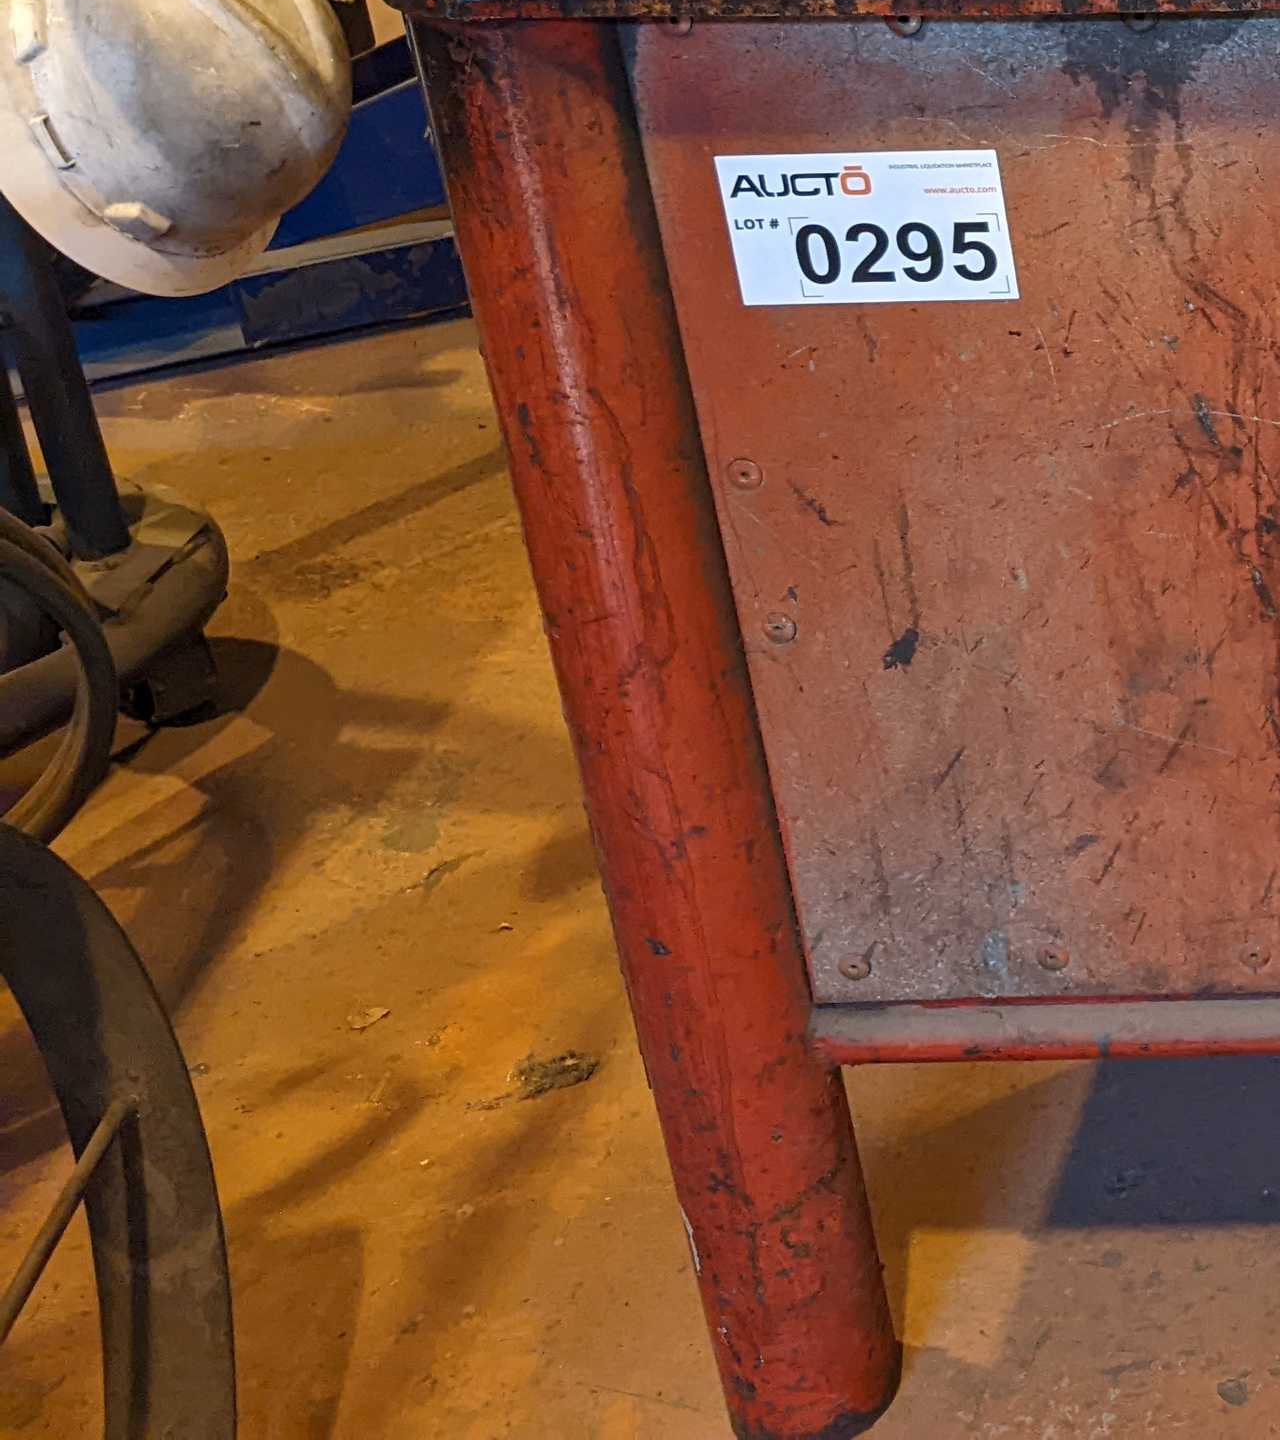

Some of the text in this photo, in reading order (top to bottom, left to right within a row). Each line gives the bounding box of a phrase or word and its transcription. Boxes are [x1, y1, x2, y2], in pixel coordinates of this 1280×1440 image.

[923, 186, 997, 194] www.aucto.com
[735, 218, 780, 231] LOT #
[795, 221, 998, 285] 0295
